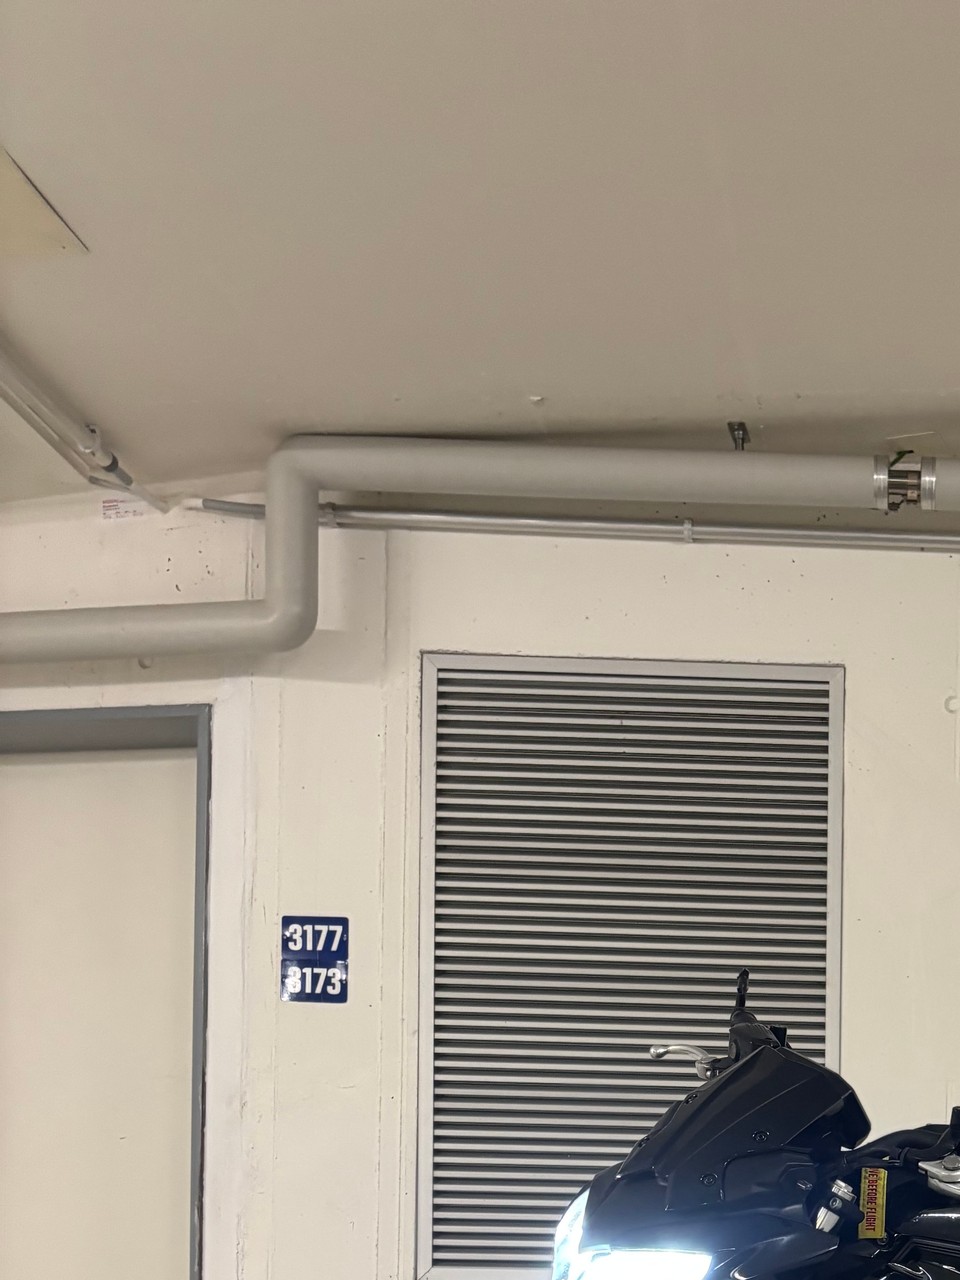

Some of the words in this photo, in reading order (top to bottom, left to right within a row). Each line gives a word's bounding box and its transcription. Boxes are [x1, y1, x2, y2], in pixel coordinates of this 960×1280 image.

[287, 923, 343, 952] 3177
[866, 1180, 878, 1206] BEFORE
[865, 1207, 877, 1232] FLIGHT
